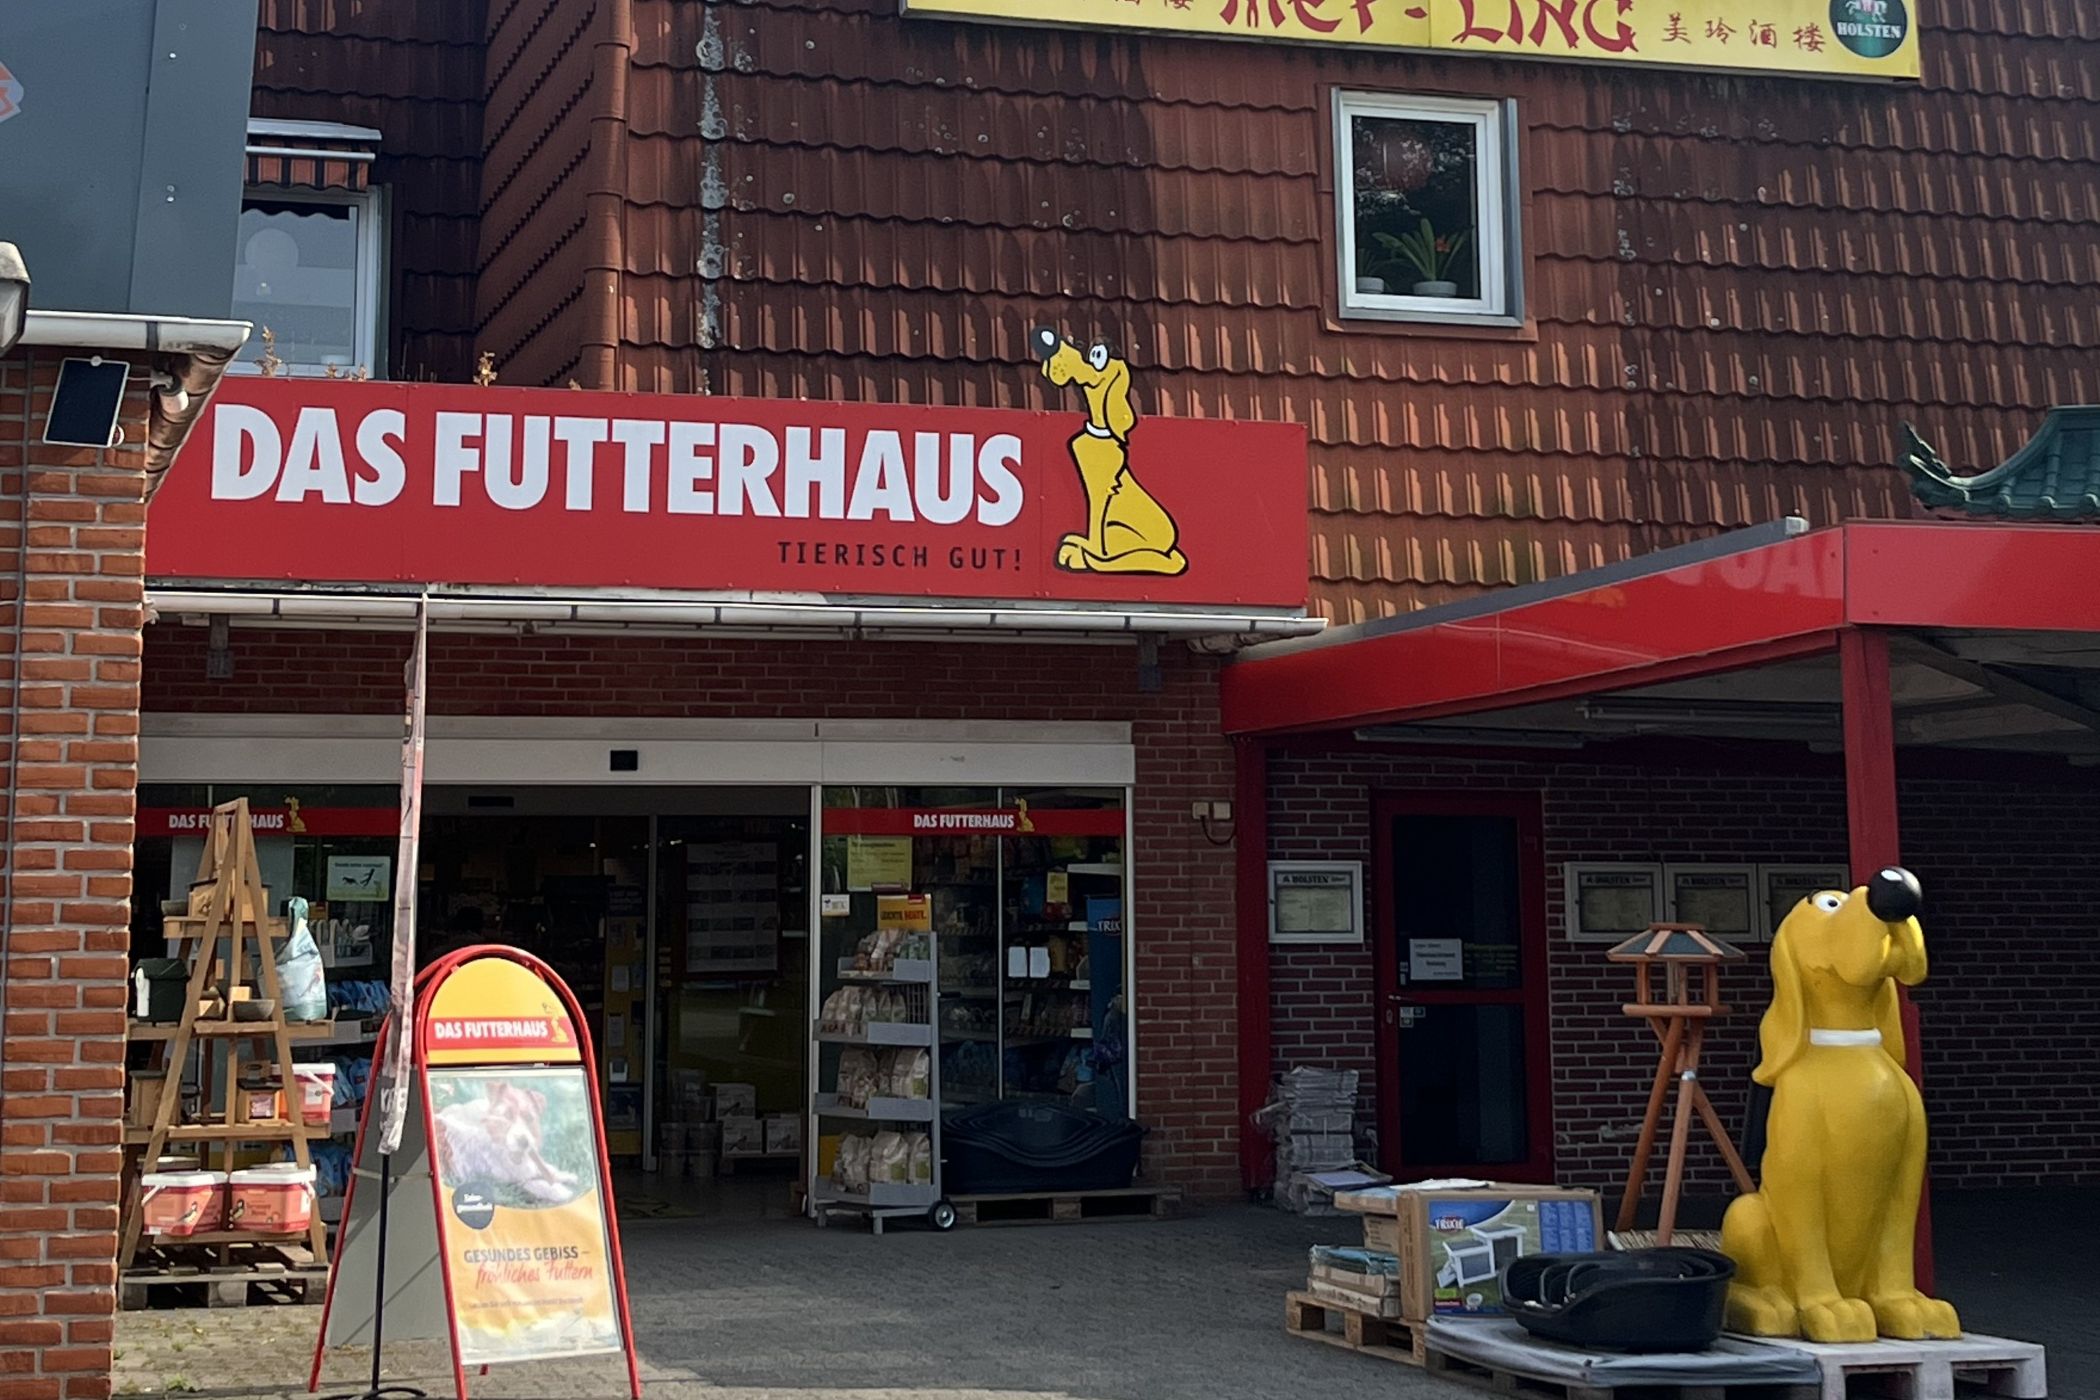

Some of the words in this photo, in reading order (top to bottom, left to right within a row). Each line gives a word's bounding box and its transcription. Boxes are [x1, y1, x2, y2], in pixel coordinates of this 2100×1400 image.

[1451, 0, 1639, 53] LING
[1837, 21, 1901, 39] HOLSTEN
[210, 403, 407, 506] DAS
[433, 411, 1024, 526] FUTTERHAUS
[777, 541, 928, 568] TIERISCH
[949, 547, 1021, 571] GUT!
[168, 814, 196, 829] DAS
[914, 814, 937, 828] DAS
[939, 814, 1015, 828] FUTTERHAUS
[434, 1022, 463, 1039] DAS
[464, 1020, 549, 1038] FUTTERHAUS
[464, 1247, 531, 1263] GESUNDES
[533, 1246, 579, 1261] GEBISS
